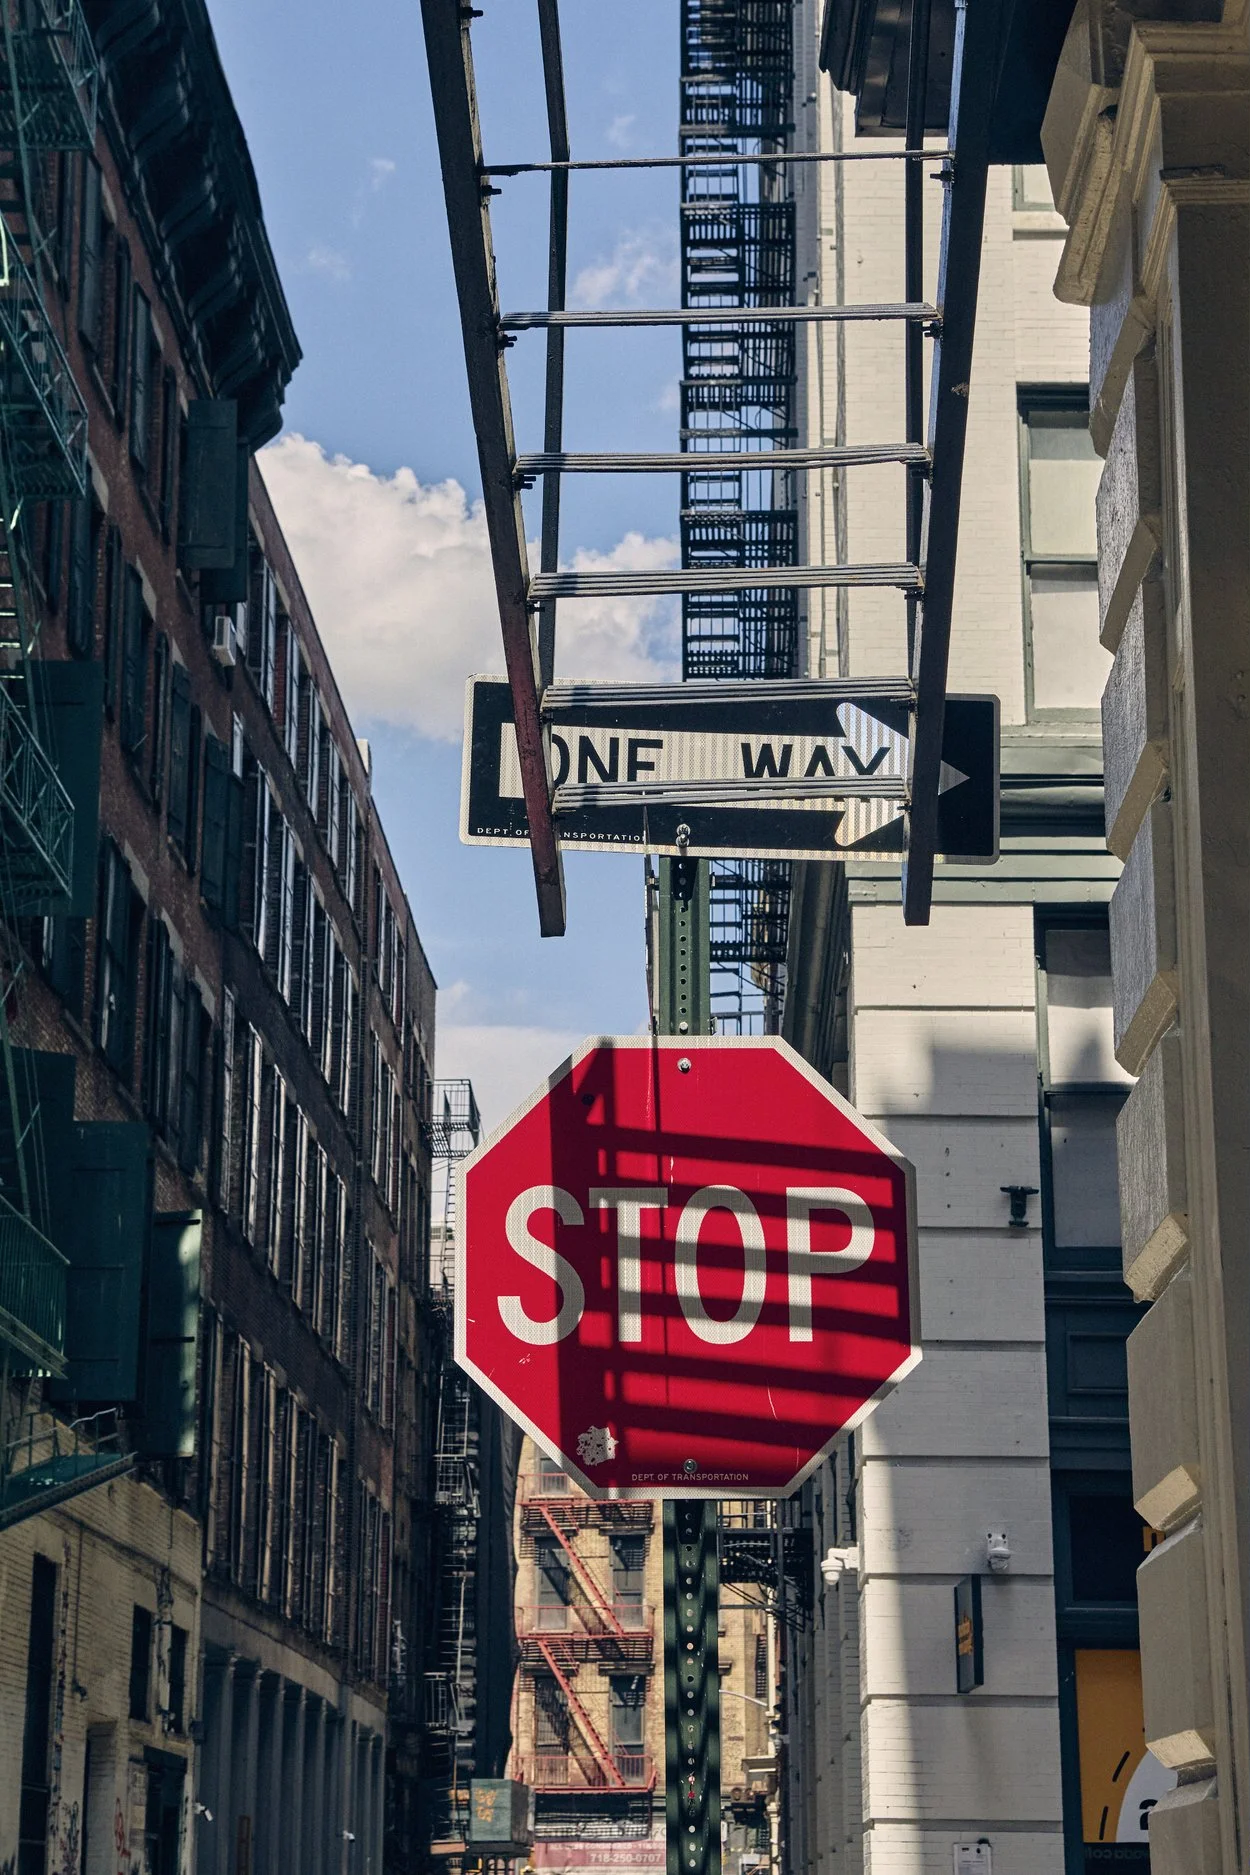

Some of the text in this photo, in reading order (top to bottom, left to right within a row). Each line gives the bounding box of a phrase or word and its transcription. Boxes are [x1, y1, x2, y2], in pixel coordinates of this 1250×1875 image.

[741, 742, 891, 802] WAY
[559, 831, 645, 842] NSPORTATIO
[497, 1184, 875, 1346] STOP
[657, 1473, 669, 1481] OF
[672, 1473, 749, 1481] TRANSPORTATION
[589, 1853, 661, 1863] 718-250-0707
